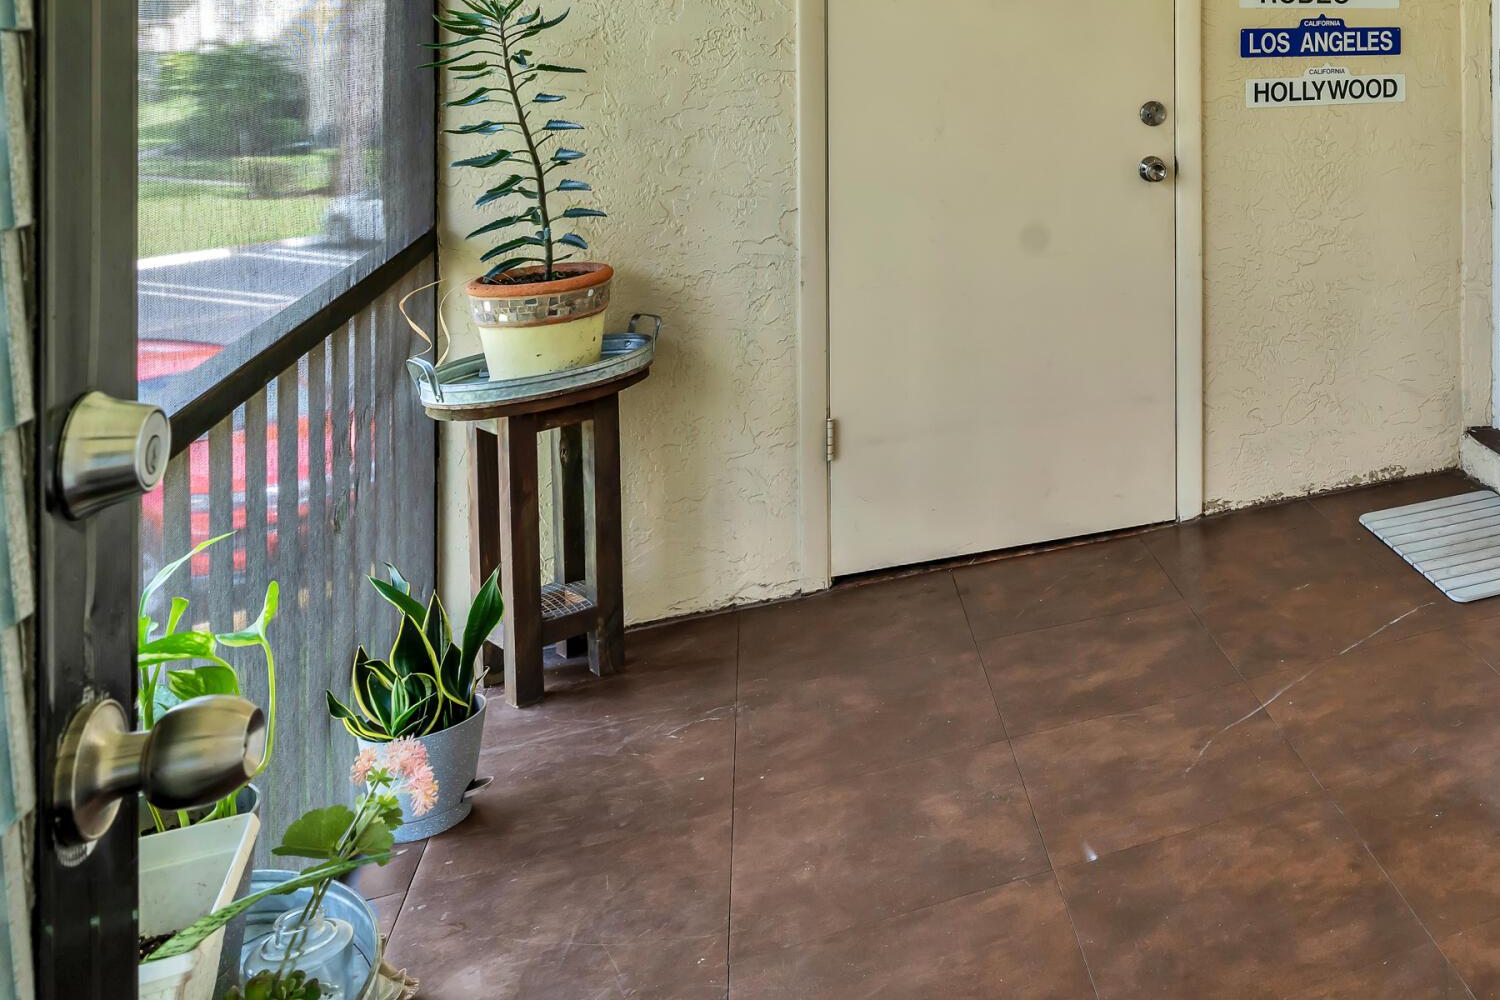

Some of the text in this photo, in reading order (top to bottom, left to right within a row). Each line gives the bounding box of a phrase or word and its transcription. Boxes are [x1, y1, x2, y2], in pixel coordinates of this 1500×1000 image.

[1249, 31, 1393, 54] LOS ANGELES
[1254, 78, 1398, 103] HOLLYWOOD
